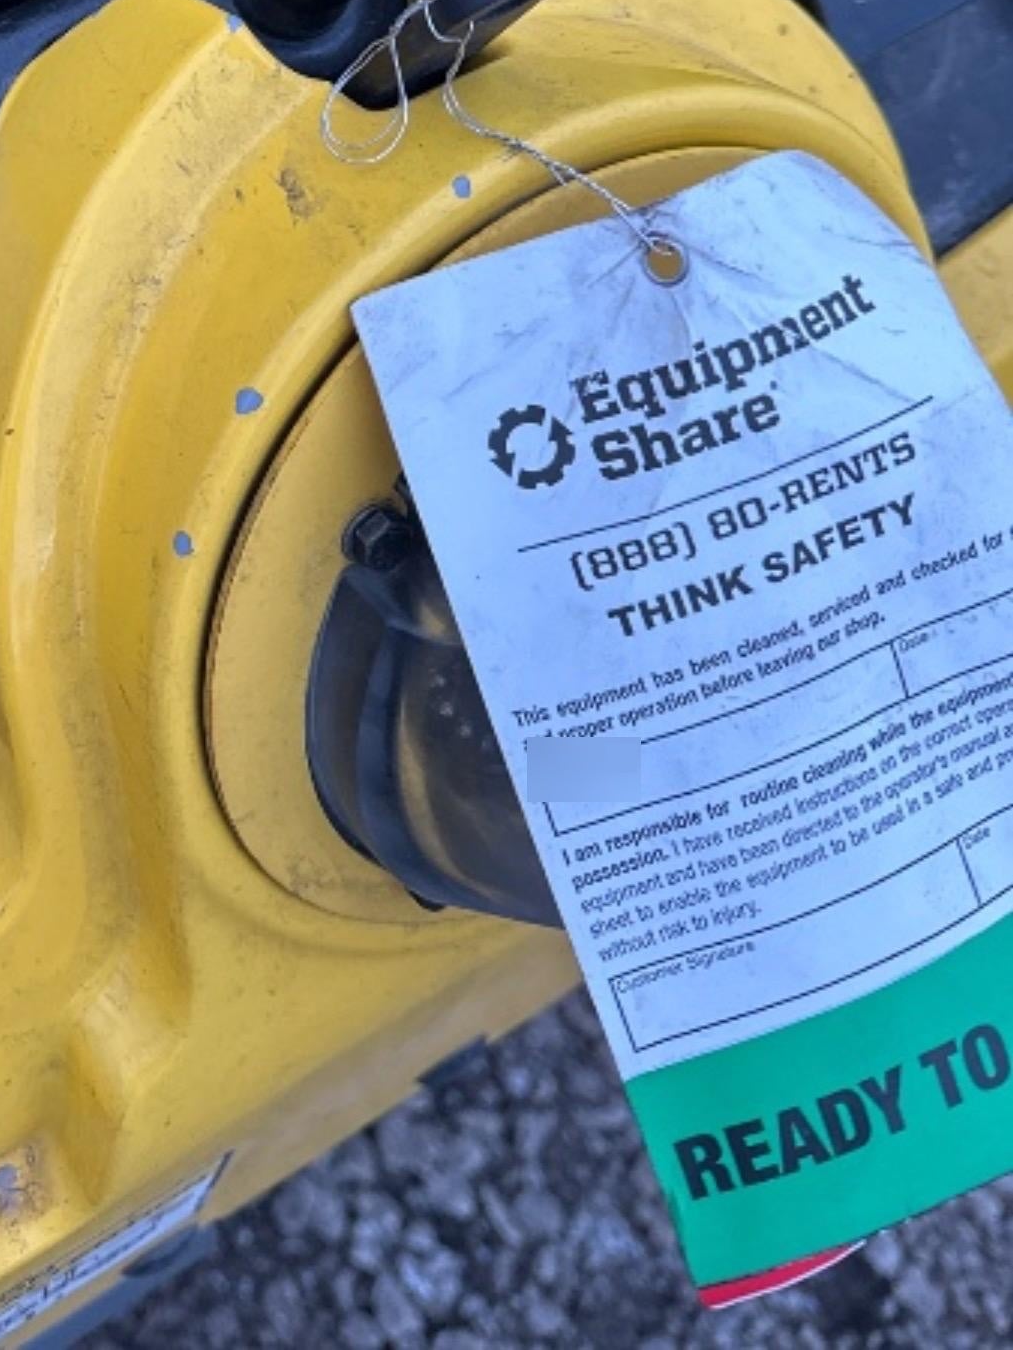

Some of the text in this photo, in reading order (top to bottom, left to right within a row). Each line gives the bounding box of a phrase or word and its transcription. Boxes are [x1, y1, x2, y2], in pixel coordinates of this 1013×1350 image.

[569, 272, 876, 425] Equipment
[571, 431, 917, 592] (888) 80-RENTS
[590, 392, 782, 482] Share
[512, 704, 551, 727] This
[556, 677, 647, 718] equipment
[651, 668, 685, 689] has
[688, 650, 732, 676] been
[809, 584, 871, 628] serviced
[875, 569, 907, 595] and
[911, 540, 979, 581] checked
[982, 531, 1003, 553] for
[607, 493, 917, 638] THINK SAFETY
[619, 687, 699, 728] operation
[699, 667, 755, 700] before
[755, 644, 815, 678] leaving
[817, 629, 841, 651] our
[844, 611, 886, 637] shop.
[562, 848, 571, 867] I
[574, 842, 603, 862] am
[604, 810, 703, 854] responsible
[706, 800, 730, 820] for
[740, 775, 798, 808] routine
[802, 744, 868, 784] cleaning
[867, 721, 907, 751] while
[909, 708, 934, 730] the
[571, 848, 671, 894] possession.
[682, 830, 723, 852] have
[726, 803, 793, 840] received
[794, 767, 878, 815] instructions
[898, 741, 922, 763] the
[924, 714, 972, 750] correct
[581, 874, 664, 914] equipment
[665, 863, 697, 887] and
[698, 852, 739, 877] have
[739, 838, 781, 864] been
[782, 811, 843, 848] directed
[842, 804, 860, 822] to
[860, 791, 883, 813] the
[884, 754, 949, 800] operator's
[950, 726, 1001, 763] manual
[589, 911, 636, 940] sheet
[635, 905, 654, 923] to
[658, 887, 711, 916] enable
[713, 878, 742, 899] the
[746, 844, 828, 888] equipment
[829, 837, 846, 855] to
[848, 827, 870, 847] be
[872, 803, 905, 835] used
[935, 773, 964, 799] safe
[965, 756, 993, 781] and
[598, 900, 762, 962] without risk to injury.
[673, 1023, 1012, 1200] READY TO
